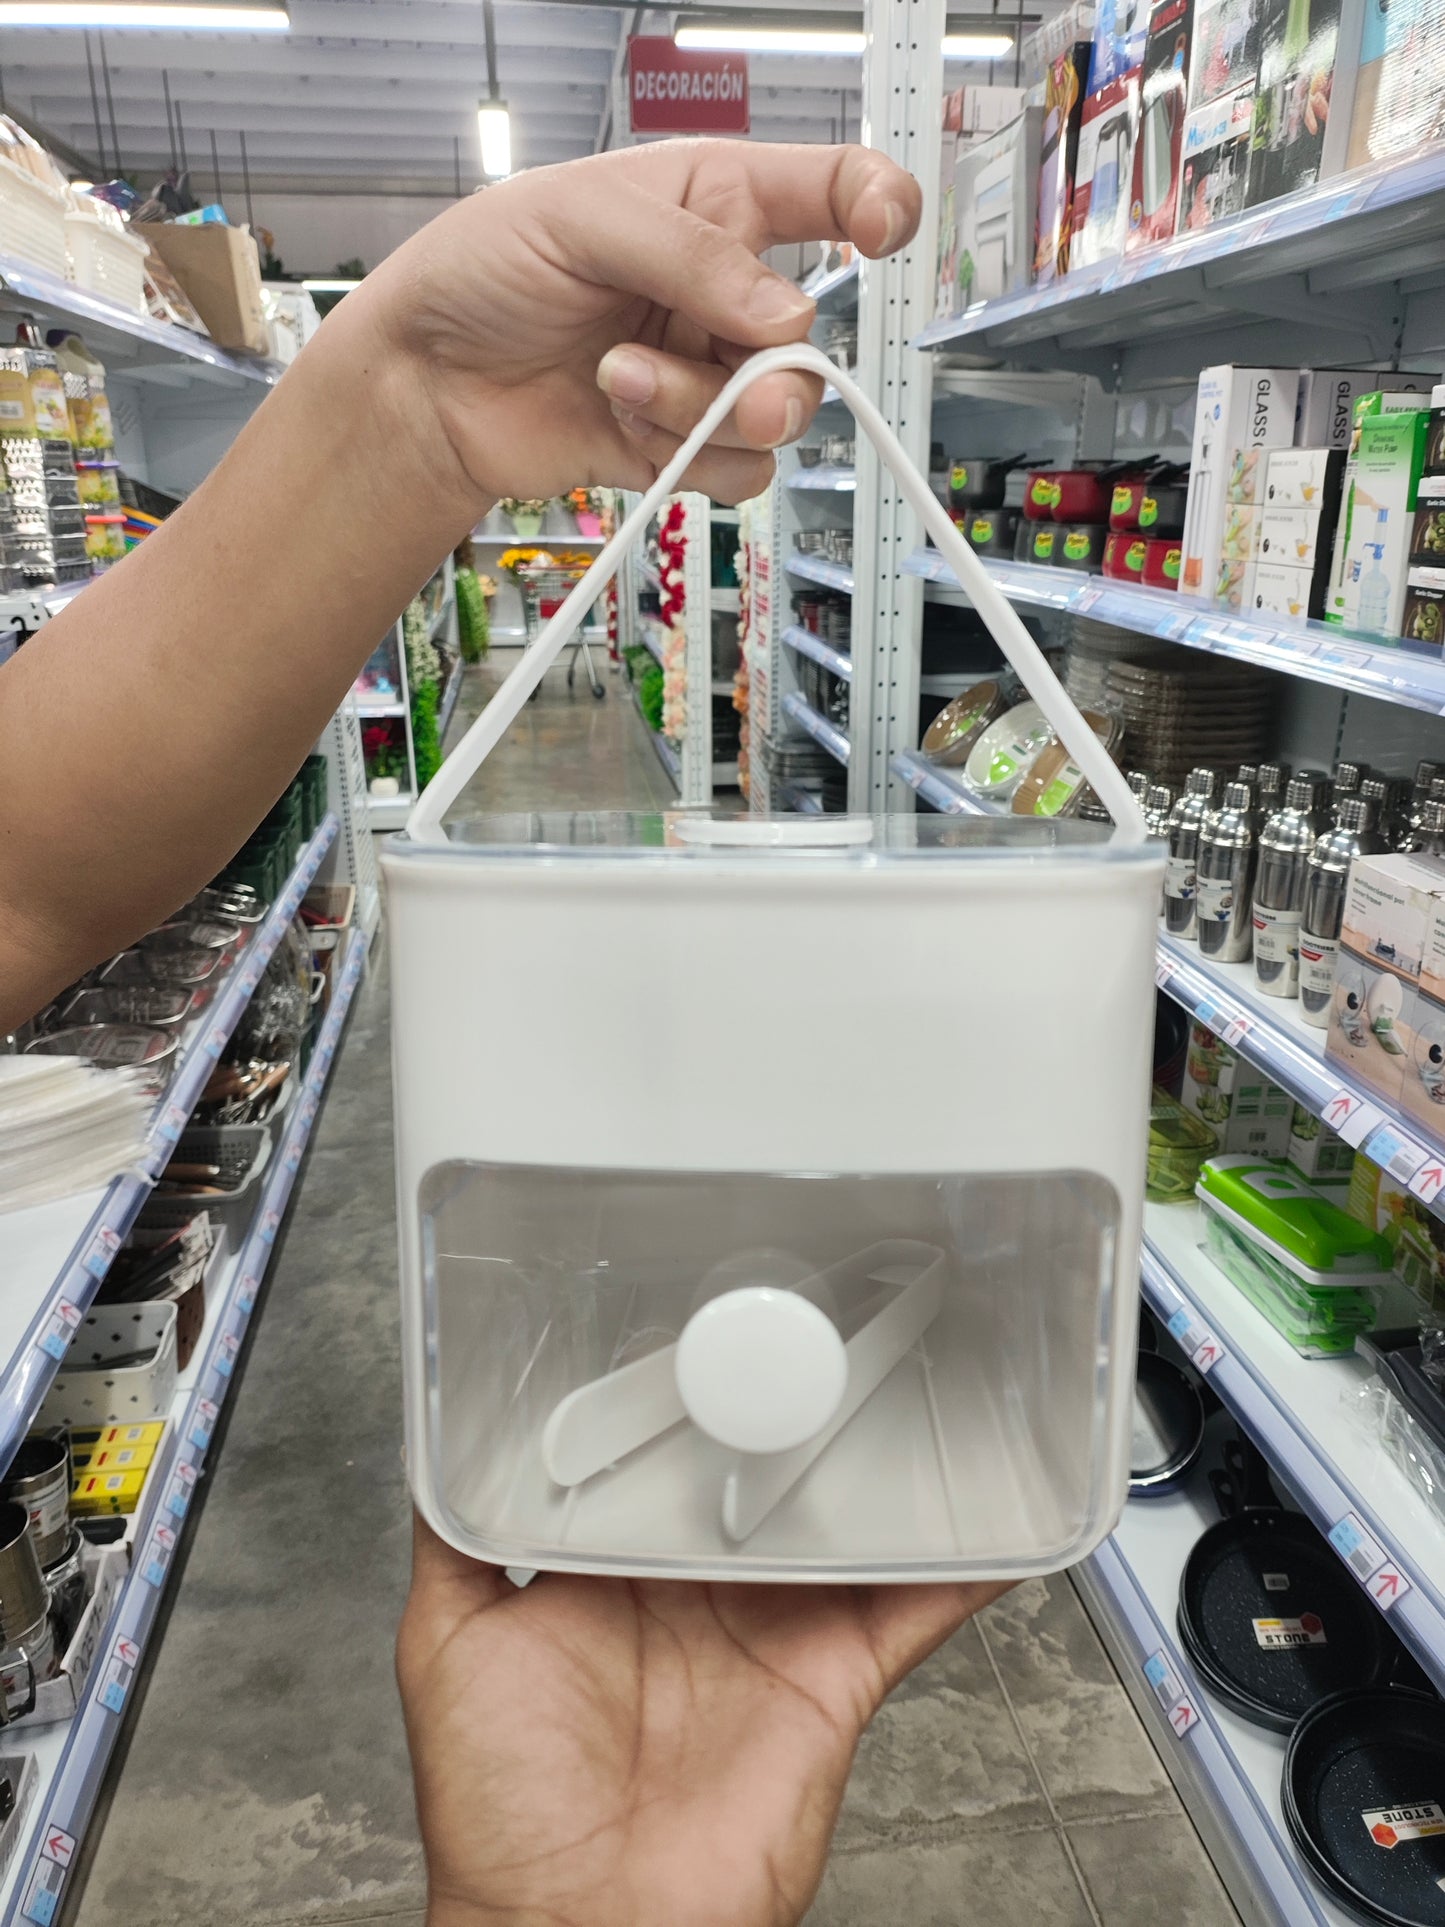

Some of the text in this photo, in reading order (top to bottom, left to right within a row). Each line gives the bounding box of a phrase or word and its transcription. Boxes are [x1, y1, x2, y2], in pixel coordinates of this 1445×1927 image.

[635, 62, 744, 101] DECORACIÓN
[1253, 379, 1271, 438] GLASS
[1333, 381, 1351, 439] GLASS
[1382, 1807, 1435, 1823] STONE
